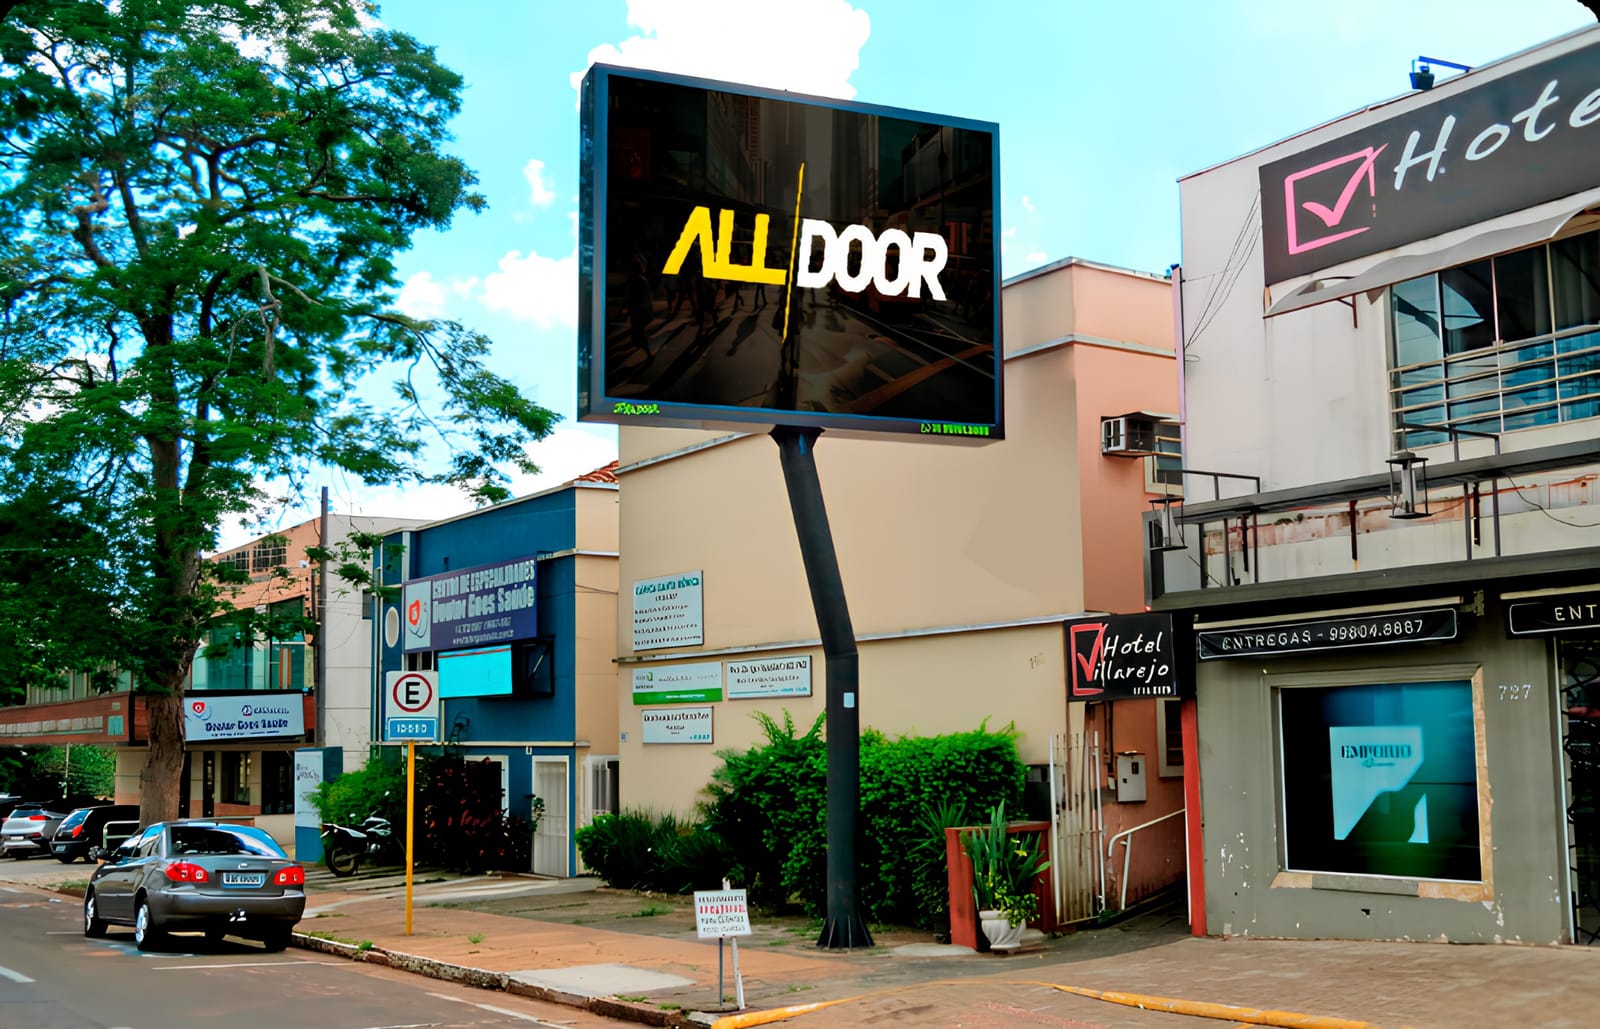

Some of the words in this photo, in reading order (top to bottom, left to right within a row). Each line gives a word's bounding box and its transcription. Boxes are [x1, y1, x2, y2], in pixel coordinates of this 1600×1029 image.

[661, 205, 787, 286] ALL
[796, 217, 949, 302] DOOR
[1554, 604, 1598, 621] ENT
[1103, 631, 1163, 658] Hotel
[1222, 630, 1312, 651] ENTREGAS
[405, 681, 421, 705] E
